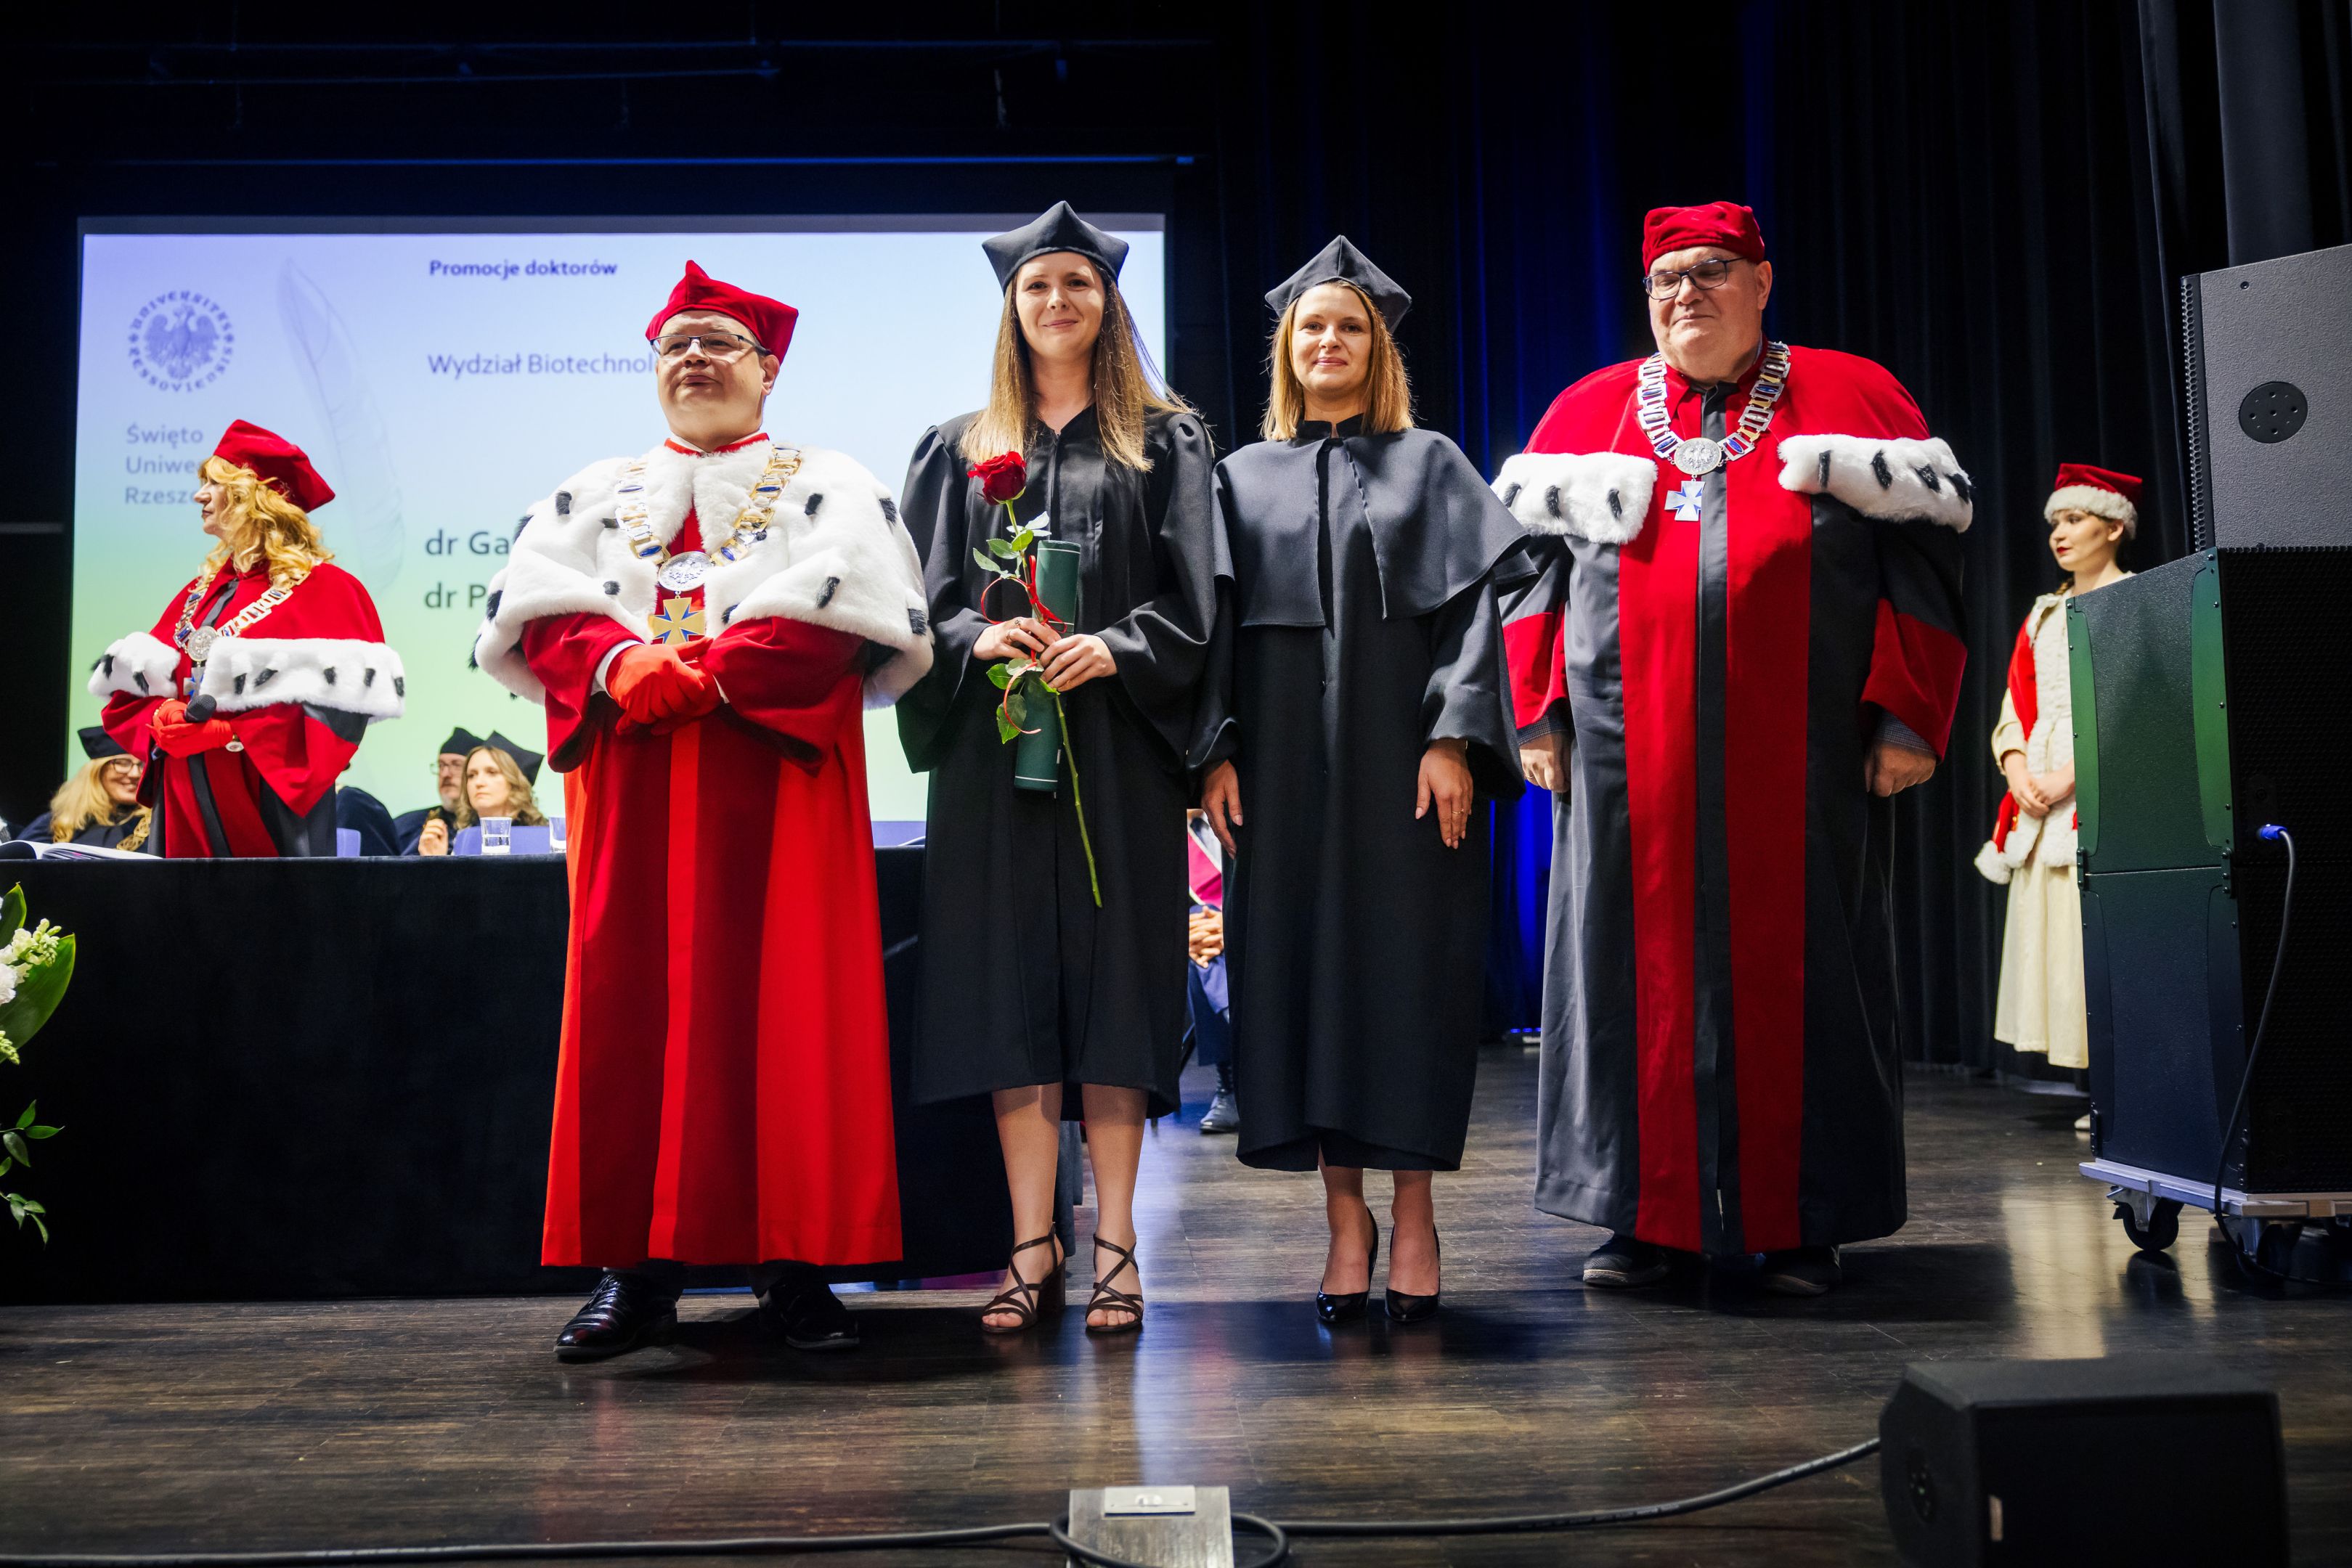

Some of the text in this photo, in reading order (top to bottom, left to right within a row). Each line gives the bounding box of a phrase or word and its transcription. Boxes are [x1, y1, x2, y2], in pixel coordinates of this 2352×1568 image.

[430, 260, 617, 279] Promocje doktorów
[428, 354, 521, 380] Wydział
[126, 422, 204, 449] Święto
[426, 529, 510, 555] dr Ga
[424, 581, 457, 608] dr
